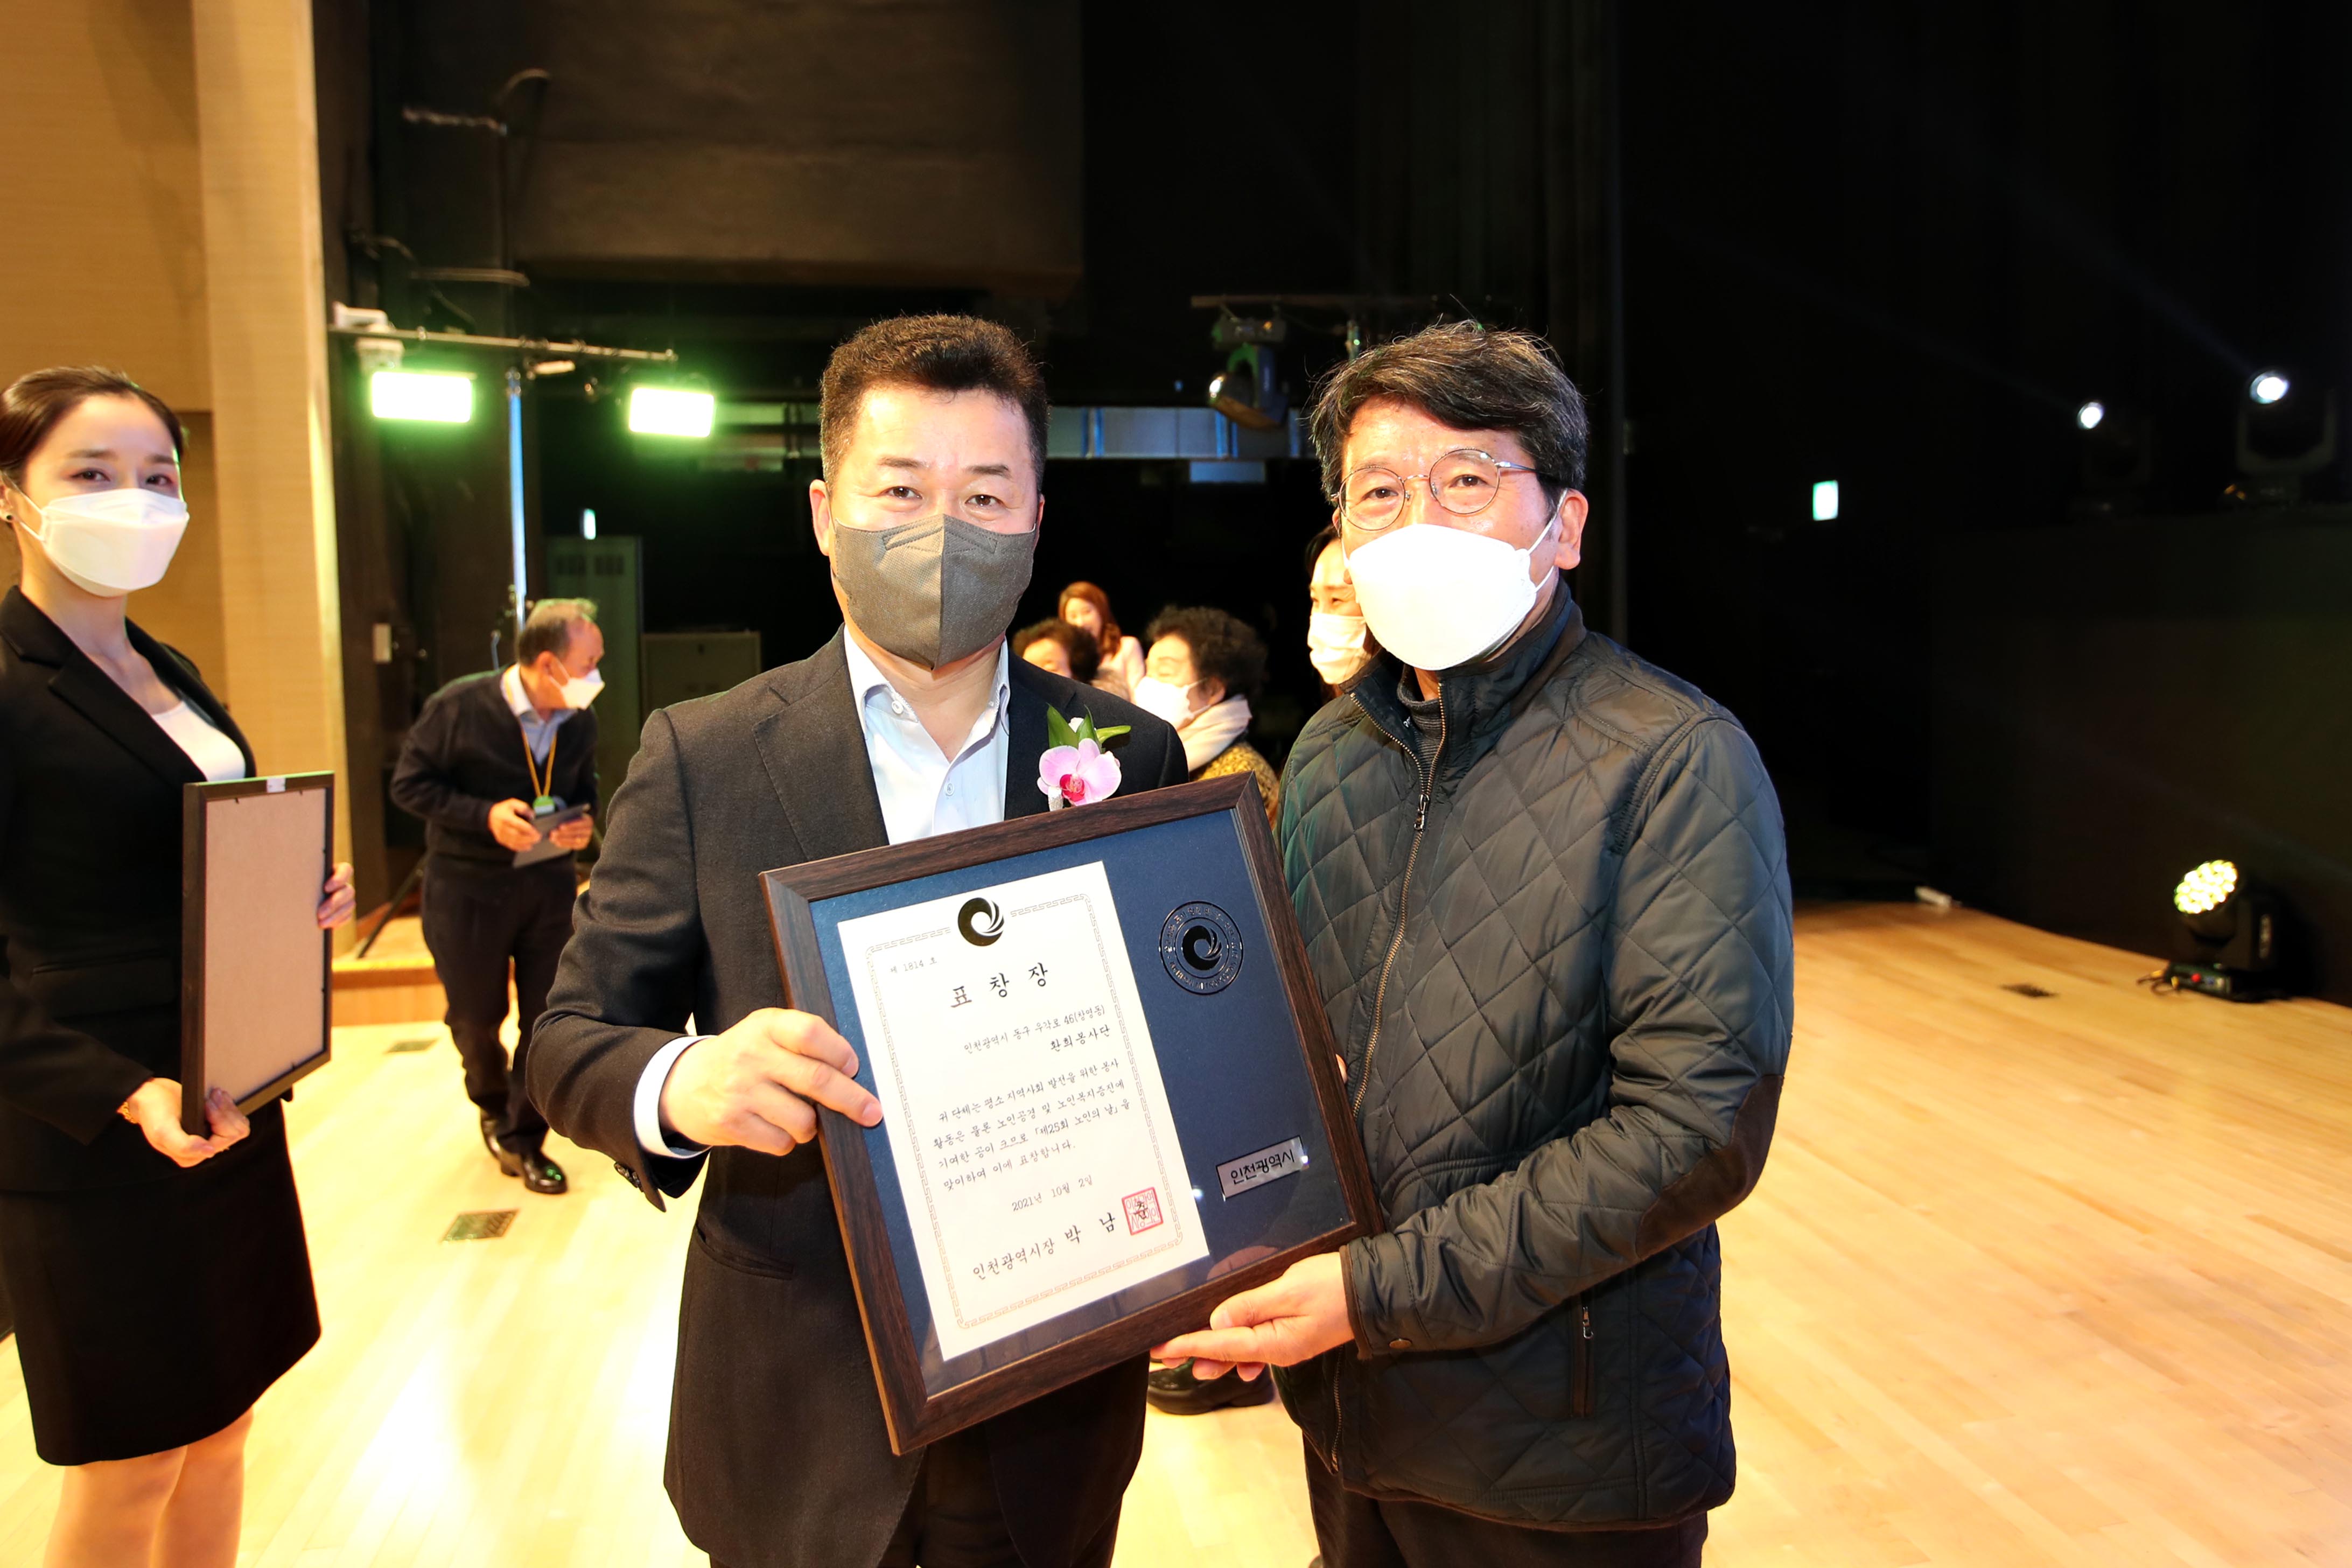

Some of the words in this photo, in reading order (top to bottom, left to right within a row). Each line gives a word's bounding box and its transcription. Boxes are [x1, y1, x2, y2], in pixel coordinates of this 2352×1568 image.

[903, 960, 924, 971] 1814
[929, 957, 937, 965] 호
[950, 985, 972, 1008] 표
[989, 972, 1010, 998] 창
[1028, 962, 1048, 987] 장
[964, 1033, 1007, 1054] 인천광역시
[1013, 1026, 1030, 1039] 동구
[1035, 1019, 1061, 1032] 우각로
[1064, 1005, 1104, 1024] 46(창영동)
[1051, 1024, 1110, 1052] 환희봉사단
[934, 1131, 964, 1149] 활동은
[971, 1122, 991, 1137] 물론
[998, 1107, 1037, 1130] 노인공경
[1042, 1103, 1051, 1115] 및
[1057, 1079, 1125, 1110] 노인복지증진에
[939, 1111, 948, 1122] 귀
[952, 1103, 981, 1119] 단체는
[985, 1096, 1004, 1109] 평소
[1007, 1082, 1044, 1101] 지역사회
[1048, 1073, 1075, 1089] 발전을
[1080, 1065, 1097, 1077] 위한
[1102, 1059, 1118, 1072] 봉사
[939, 1151, 969, 1168] 기여한
[975, 1143, 994, 1158] 공이
[999, 1133, 1029, 1150] 크므로
[1075, 1108, 1100, 1125] 노인의
[944, 1167, 986, 1192] 맞이하여
[993, 1159, 1012, 1173] 이에
[1020, 1139, 1075, 1165] 표창합니다.
[1231, 1149, 1294, 1185] 인천광역시
[1012, 1193, 1042, 1212] 2021년
[1051, 1182, 1070, 1197] 10월
[1079, 1175, 1092, 1188] 2일
[974, 1238, 1054, 1280] 인천광역시장
[1065, 1225, 1081, 1244] 박
[1099, 1212, 1115, 1233] 남
